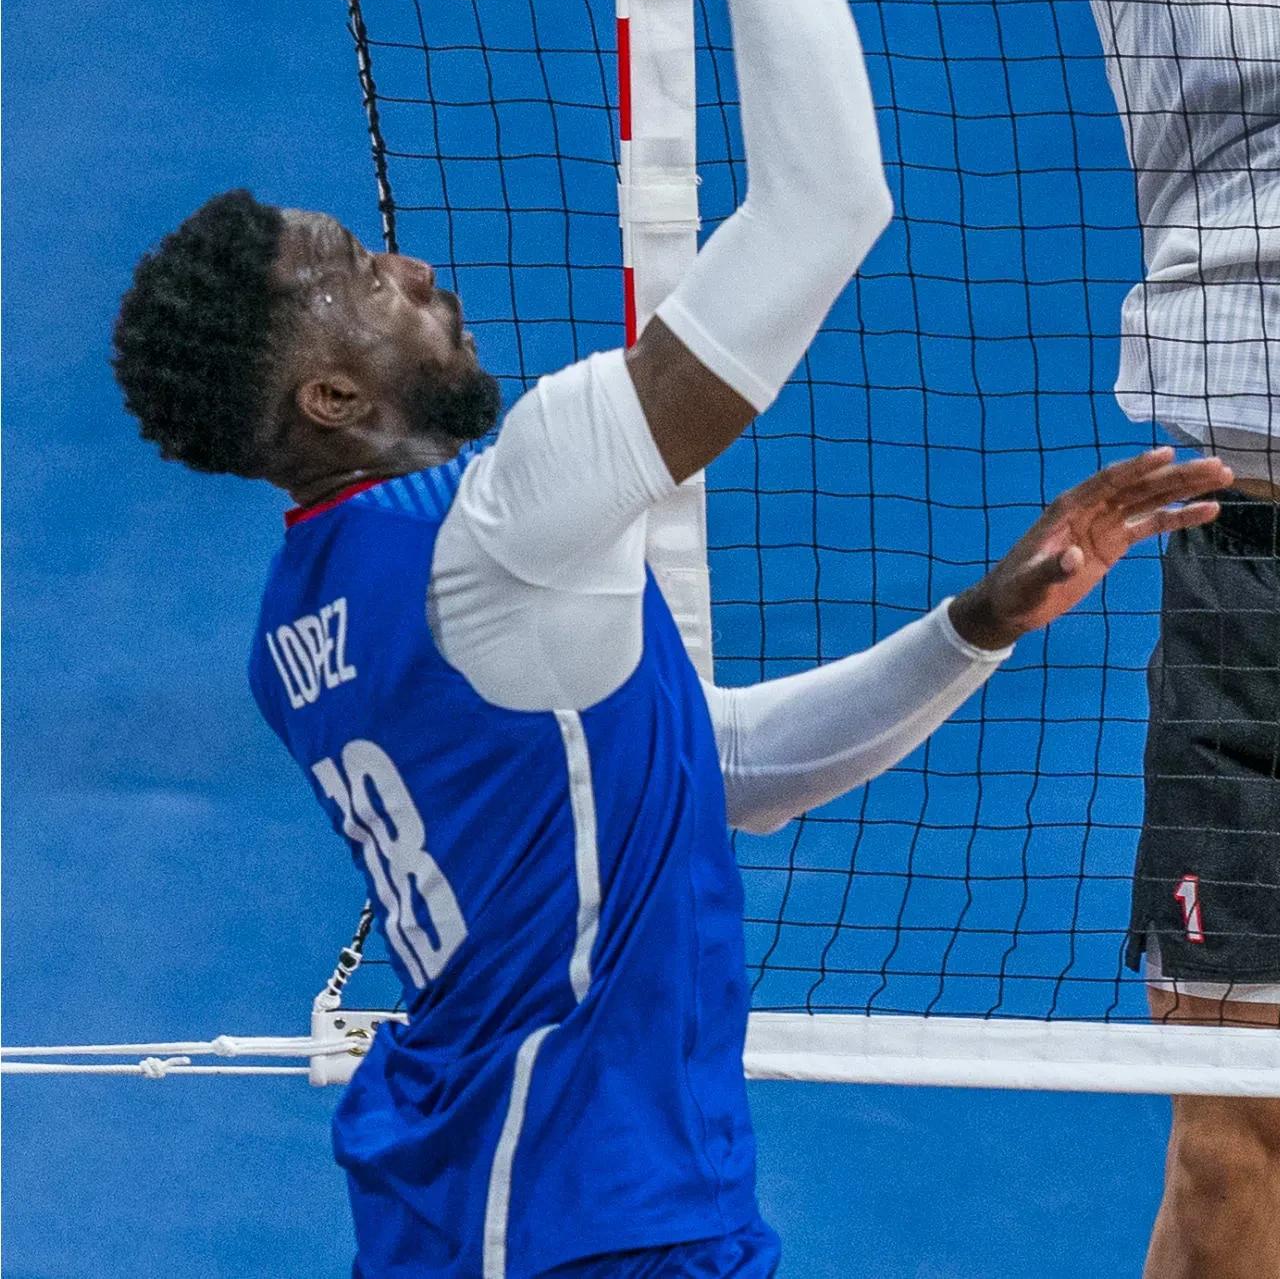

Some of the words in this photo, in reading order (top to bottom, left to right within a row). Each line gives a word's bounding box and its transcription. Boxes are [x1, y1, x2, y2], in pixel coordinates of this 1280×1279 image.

[266, 597, 356, 709] LOPEZ
[311, 739, 468, 989] 18
[1174, 874, 1204, 943] 1
